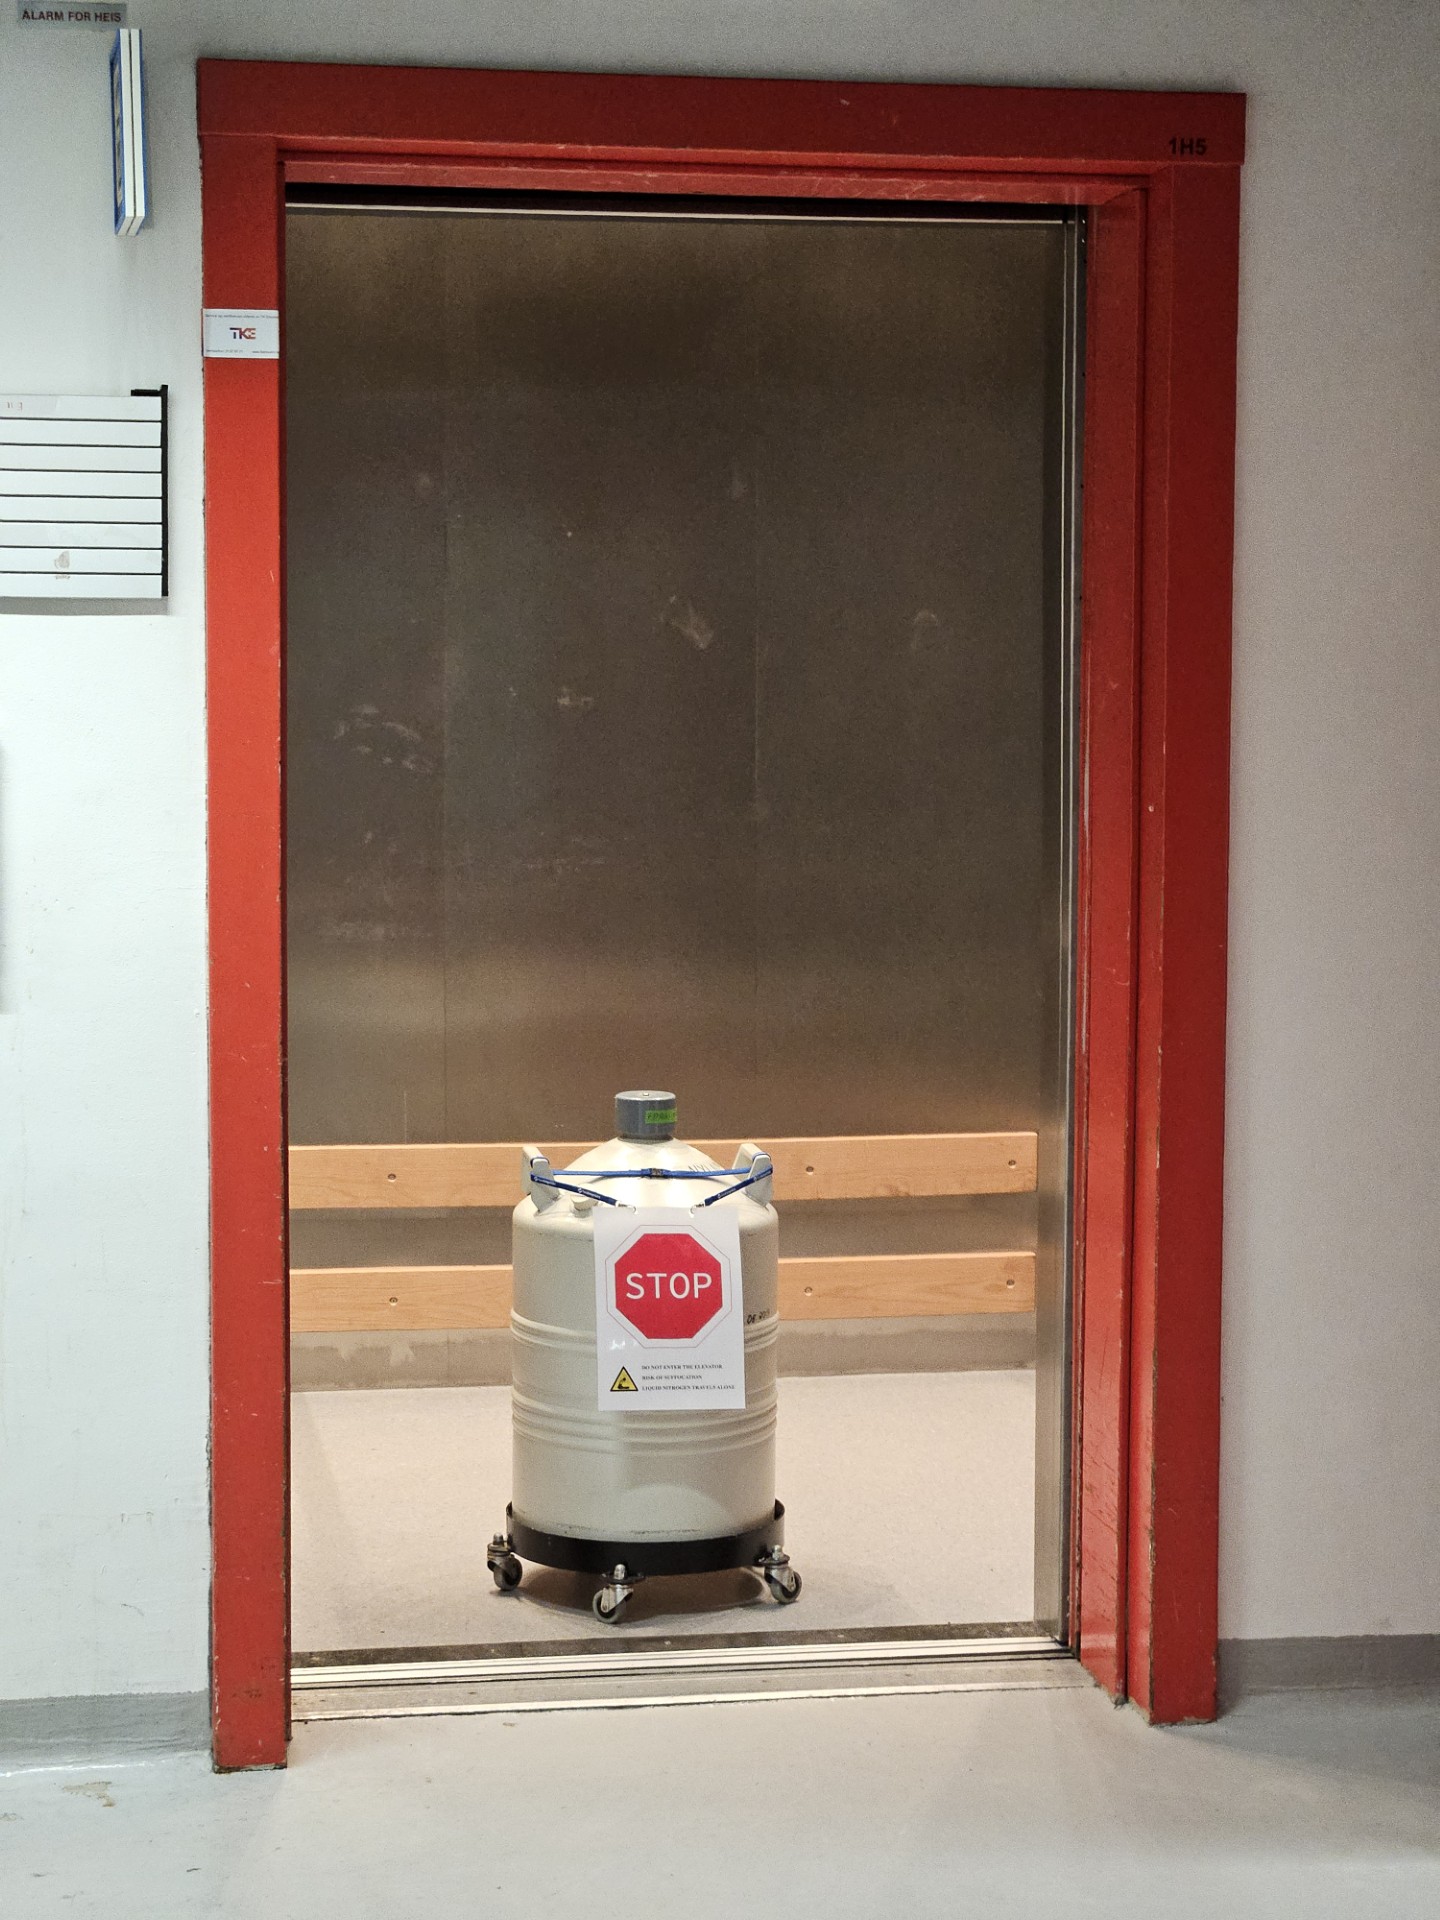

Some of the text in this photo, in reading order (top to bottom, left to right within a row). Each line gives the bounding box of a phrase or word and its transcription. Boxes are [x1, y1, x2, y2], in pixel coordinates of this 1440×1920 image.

[22, 9, 121, 22] ALARM FOR HEIS
[1169, 137, 1207, 155] 1H5
[229, 327, 256, 339] TKE
[626, 1272, 712, 1299] STOP
